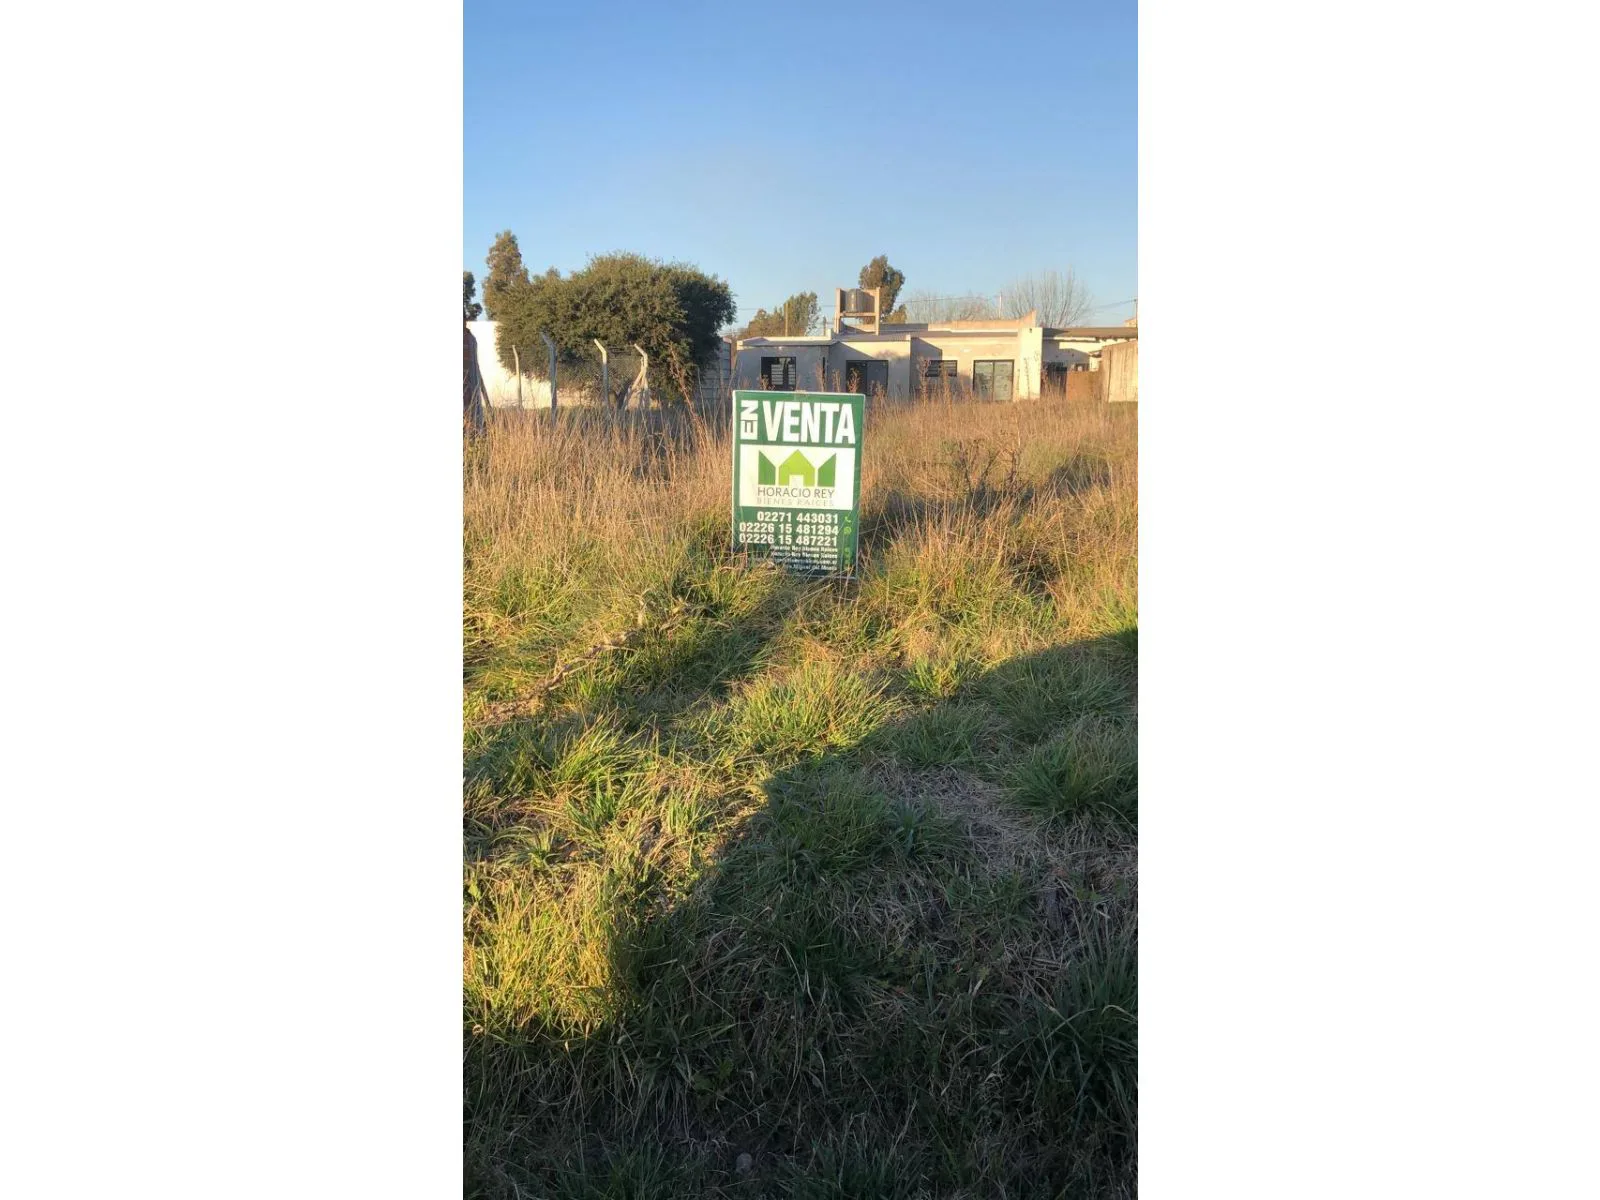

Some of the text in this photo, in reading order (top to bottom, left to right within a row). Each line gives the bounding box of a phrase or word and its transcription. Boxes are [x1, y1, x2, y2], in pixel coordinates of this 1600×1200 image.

[740, 400, 856, 444] EN VENTA
[758, 486, 834, 499] HORACIO REY
[757, 512, 838, 524] 02271 443031
[739, 522, 839, 536] 02226 15 481294
[739, 533, 837, 546] 02226 15 487221
